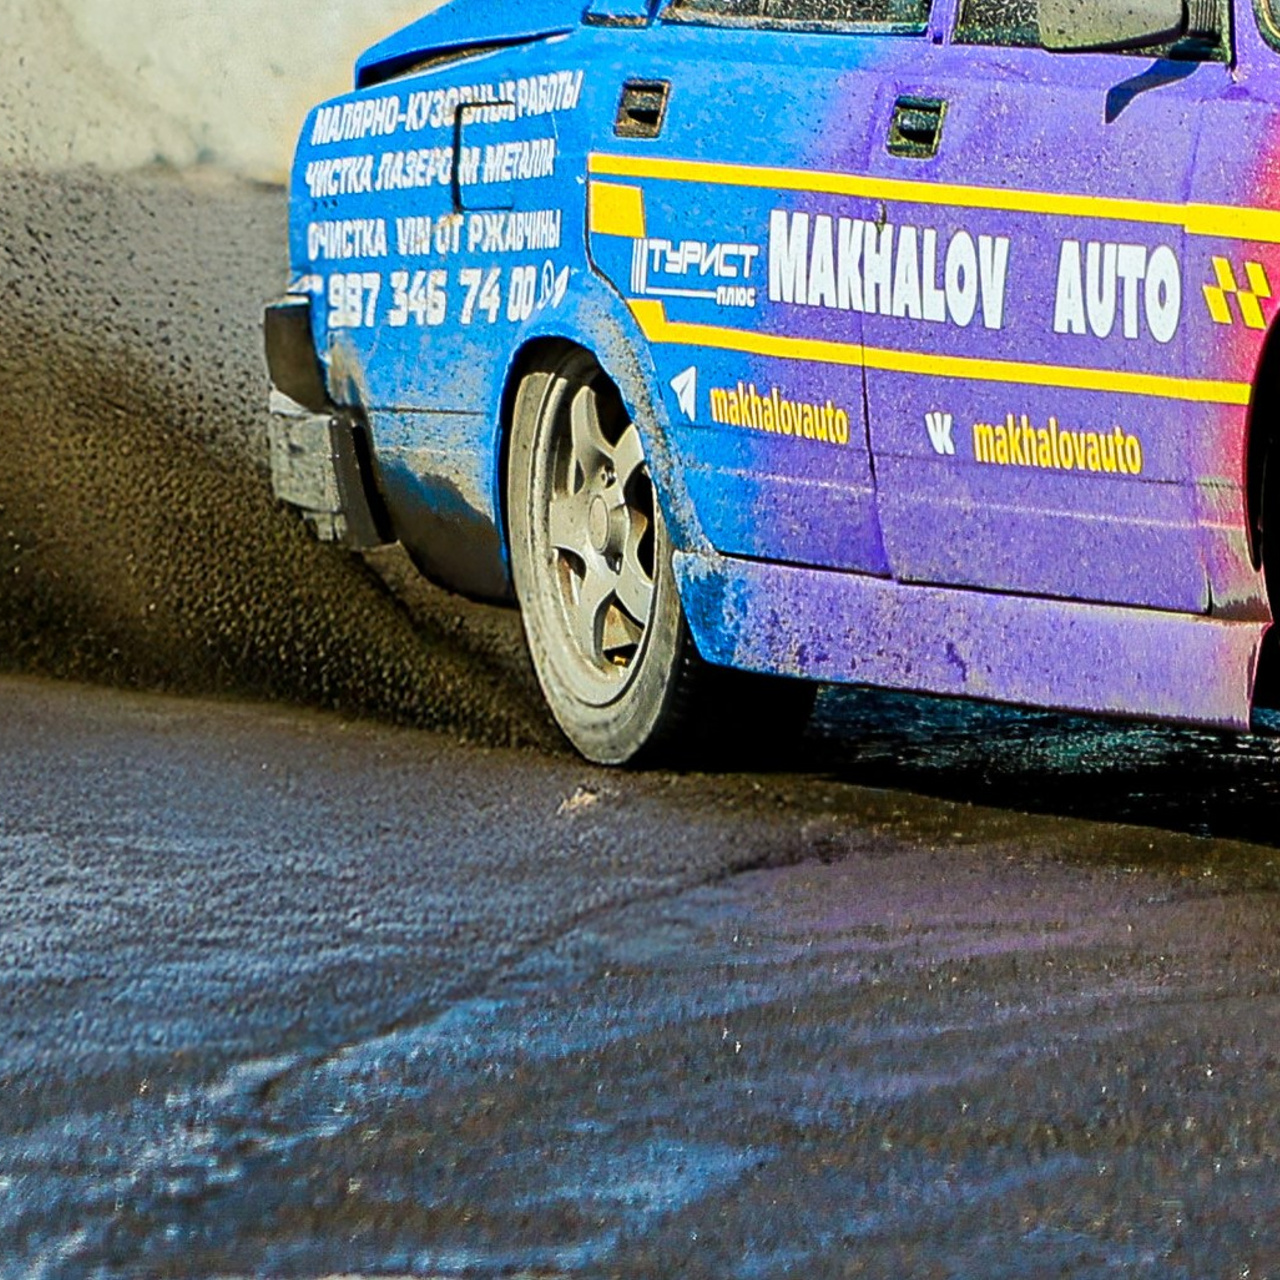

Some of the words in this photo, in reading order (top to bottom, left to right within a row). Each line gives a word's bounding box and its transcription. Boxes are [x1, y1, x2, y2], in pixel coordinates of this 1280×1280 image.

[311, 81, 516, 146] МАЛЯРНО-КУЗОВНЫЕ
[517, 69, 584, 118] РАБОТЫ
[305, 154, 372, 198] ЧИСТКА
[375, 146, 480, 196] ЛАЗЕРОМ
[483, 137, 556, 185] МЕТАЛЛА
[307, 217, 388, 261] ОЧИСТКА
[396, 214, 432, 256] VIN
[436, 213, 464, 255] ОТ
[467, 208, 562, 254] РЖАВЧИНЫ
[648, 238, 760, 278] ТУРИСТ
[328, 271, 381, 329] 987
[388, 269, 447, 328] 346
[459, 267, 502, 325] 74
[507, 265, 537, 322] 00
[767, 208, 1011, 330] MAKHALOV
[1052, 239, 1182, 344] AUTO
[709, 382, 850, 446] makhalovauto
[972, 416, 1143, 475] makhalovauto
